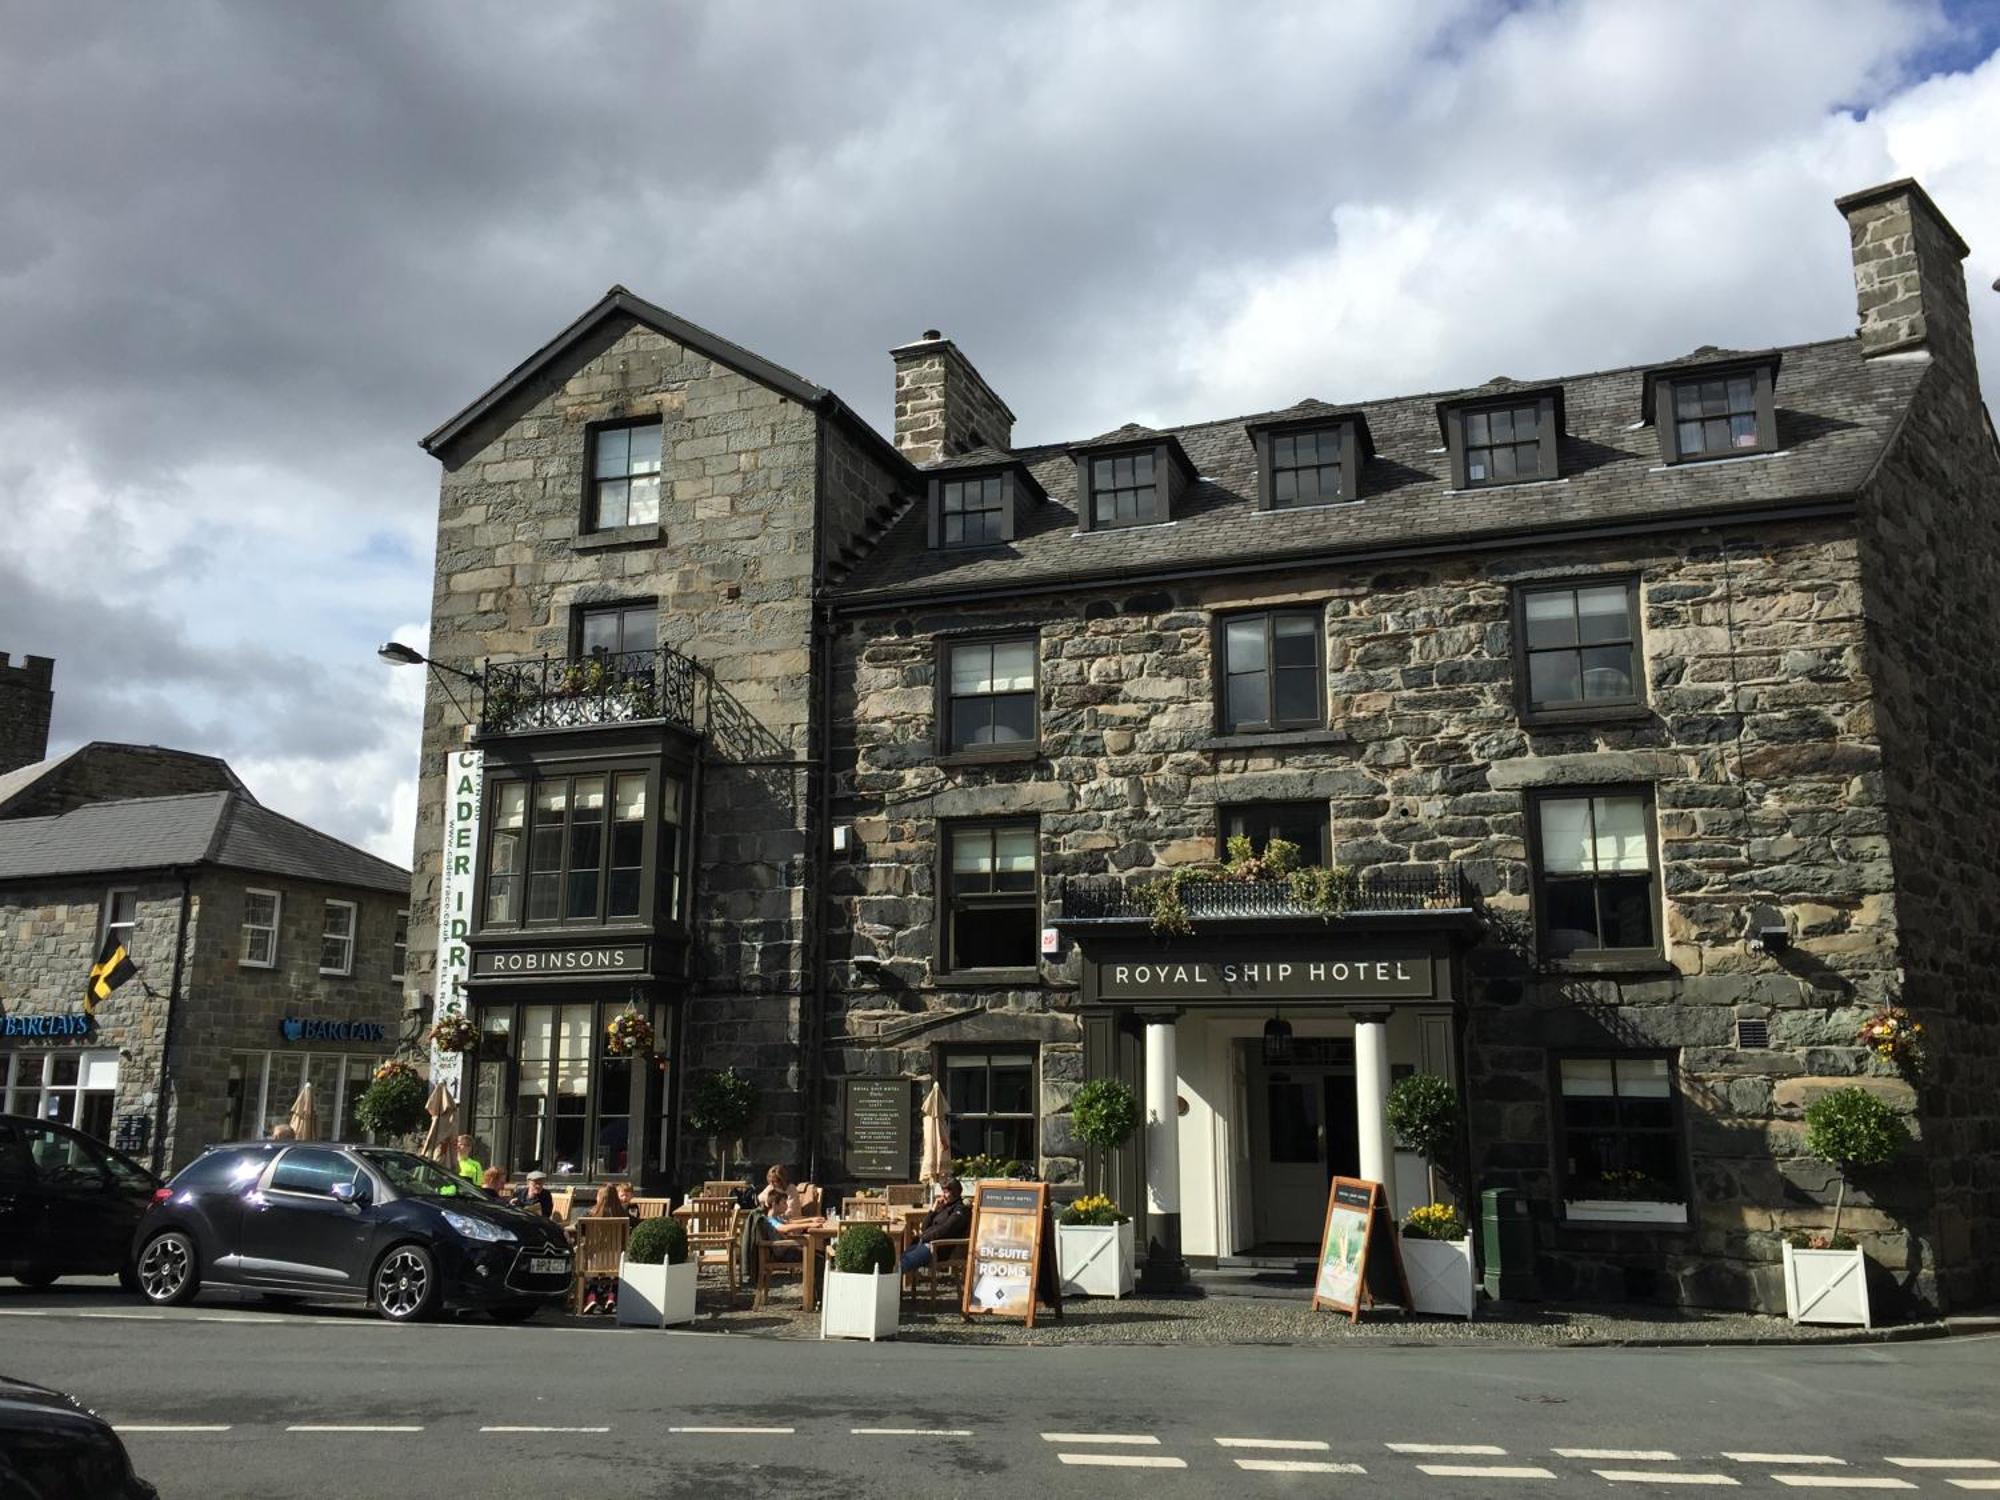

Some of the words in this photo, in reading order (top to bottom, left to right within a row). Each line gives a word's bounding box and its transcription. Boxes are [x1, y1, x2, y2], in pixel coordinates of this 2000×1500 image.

[454, 752, 474, 875] CADER
[443, 820, 455, 942] www.cader-race.co.uk
[494, 950, 624, 970] ROBINSONS
[440, 959, 449, 989] FELL
[1116, 966, 1208, 984] ROYAL
[1224, 964, 1292, 982] SHIP
[1310, 962, 1411, 981] HOTEL
[6, 1015, 87, 1035] BARCLAYS
[305, 1020, 384, 1040] BARCLAYS
[980, 1247, 1029, 1260] EN-SUITE
[979, 1263, 1027, 1277] ROOMS
